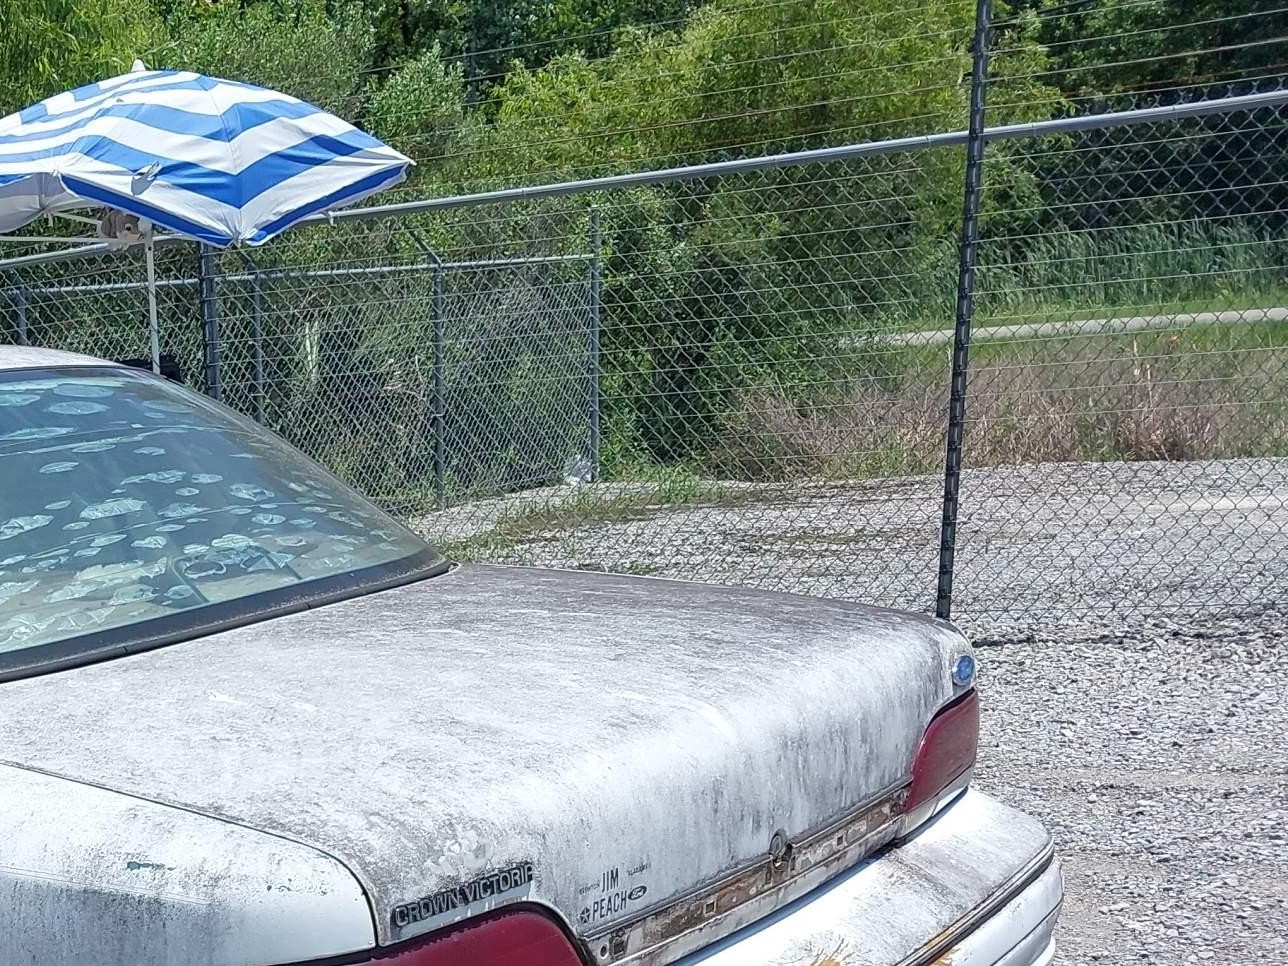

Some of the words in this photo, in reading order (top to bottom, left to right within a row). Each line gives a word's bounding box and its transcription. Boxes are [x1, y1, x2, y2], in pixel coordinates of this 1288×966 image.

[601, 867, 619, 893] JIM
[395, 892, 459, 927] CROWN
[593, 890, 628, 922] PEACH
